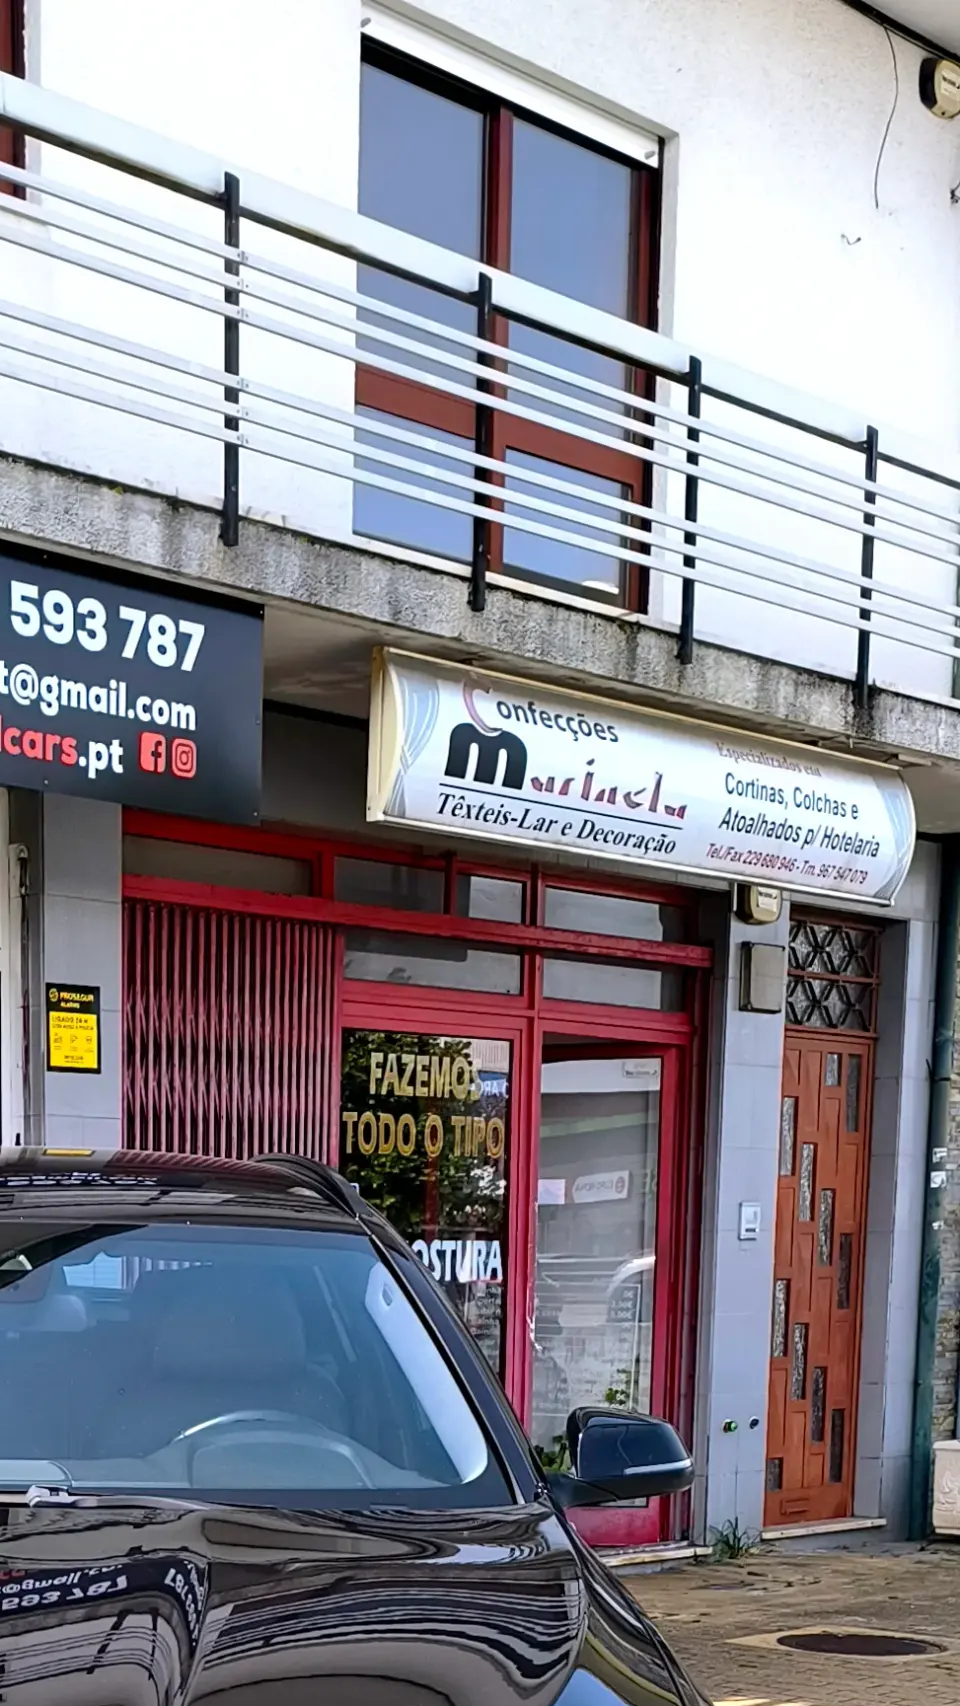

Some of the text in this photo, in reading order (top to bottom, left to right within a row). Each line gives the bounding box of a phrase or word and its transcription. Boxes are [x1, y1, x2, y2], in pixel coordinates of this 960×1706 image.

[10, 579, 108, 652] 593
[118, 605, 206, 672] 787
[725, 772, 859, 820] Cortinas, Colchas e
[436, 792, 677, 856] Têxteis-Lar e Decoração
[718, 806, 881, 858] Atoalhados p/ Hotelaria
[342, 1111, 505, 1159] TODO O TIPO
